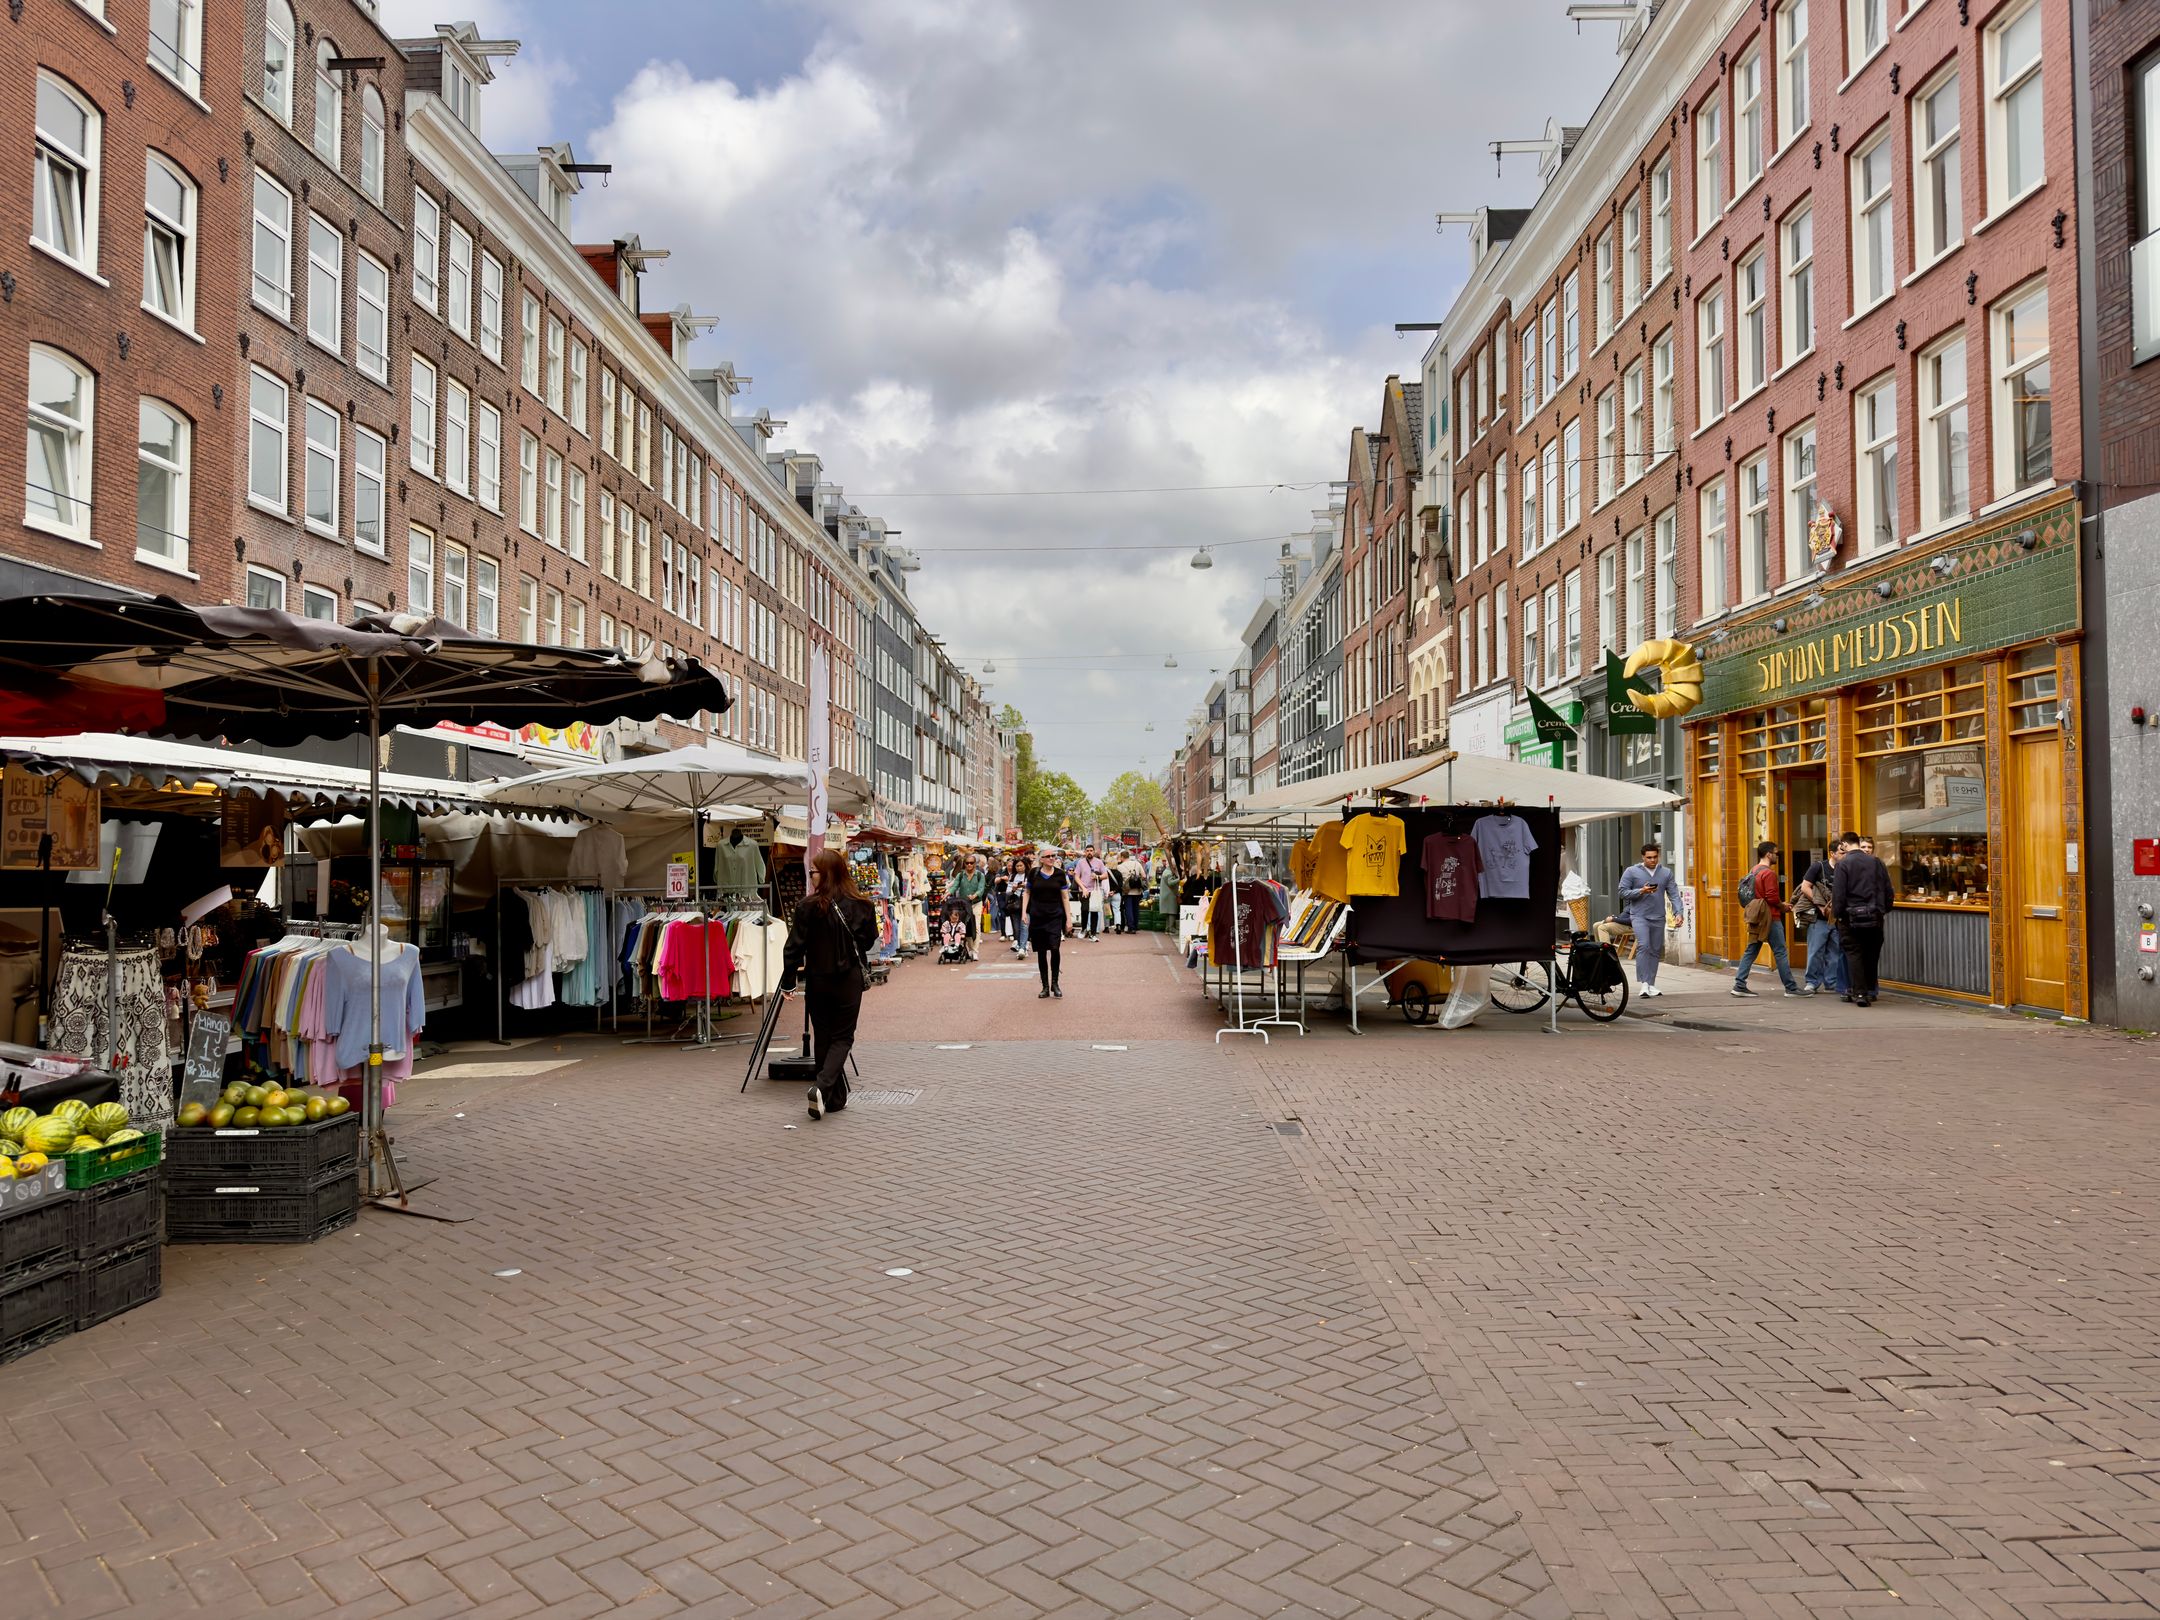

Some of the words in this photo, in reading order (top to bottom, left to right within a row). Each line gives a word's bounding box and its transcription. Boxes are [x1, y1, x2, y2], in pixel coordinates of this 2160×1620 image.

[1757, 638, 1825, 693] SIMON
[10, 777, 29, 796] ICE
[32, 778, 63, 799] LAE
[199, 1035, 212, 1062] 1
